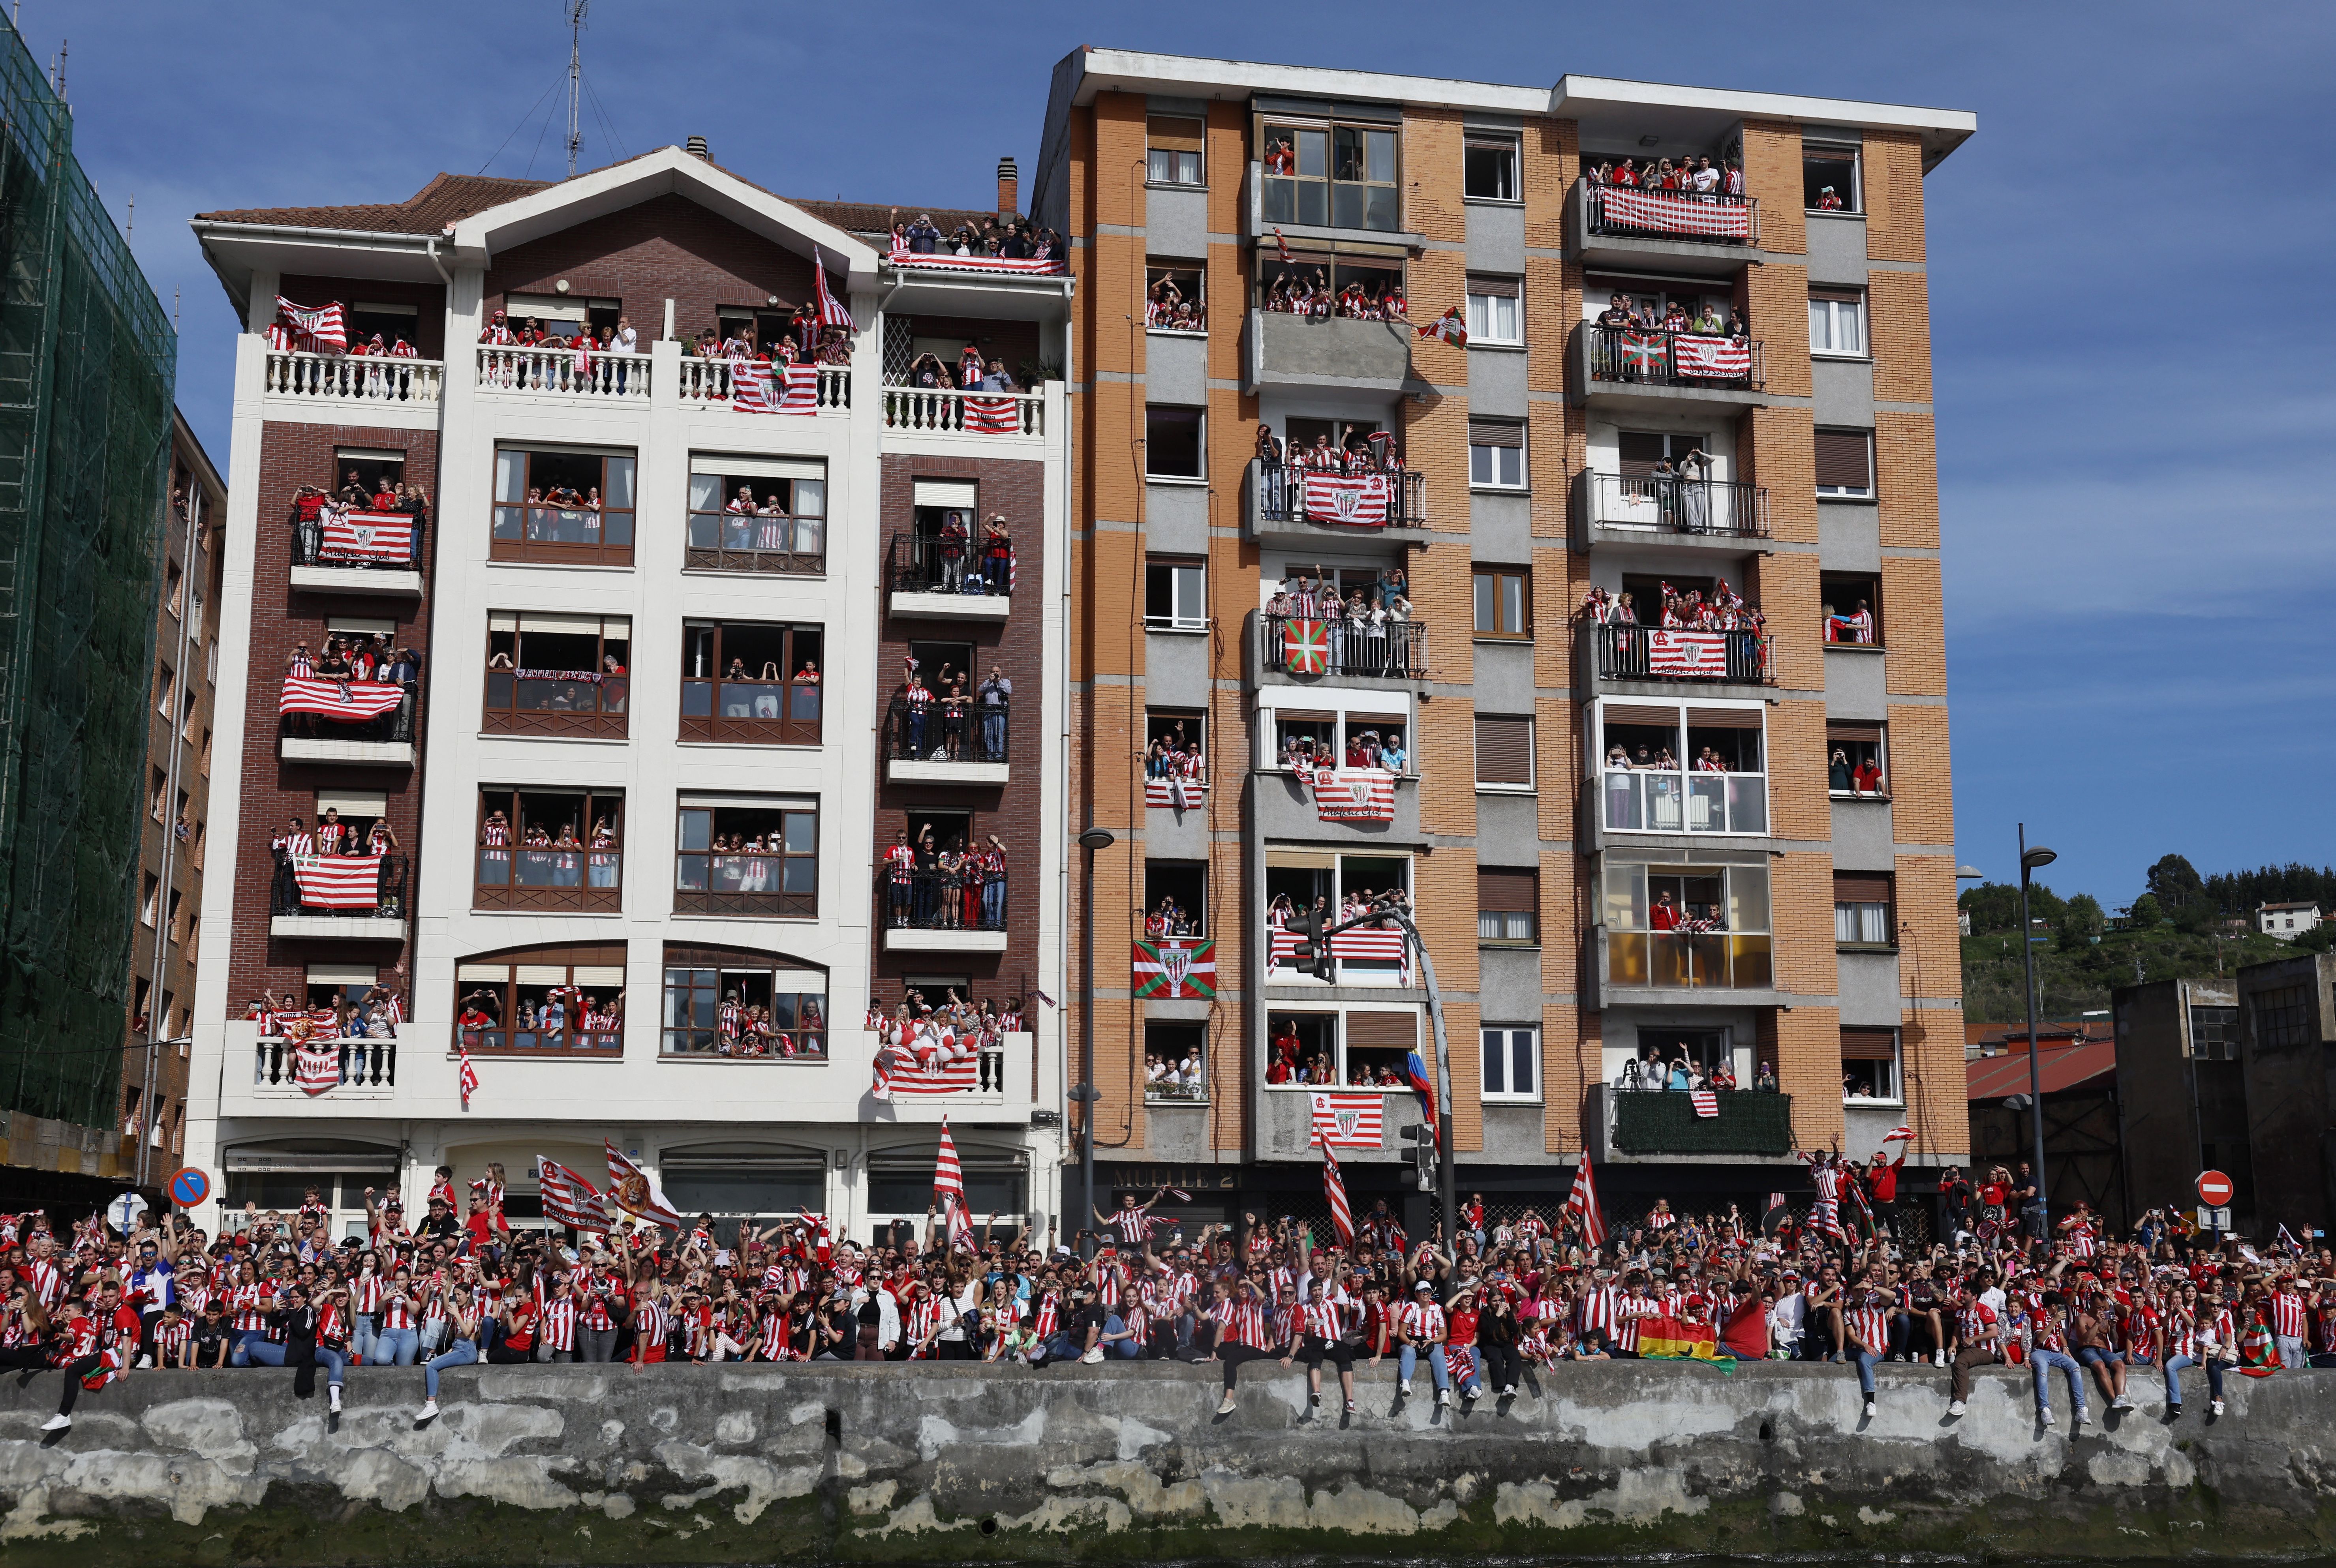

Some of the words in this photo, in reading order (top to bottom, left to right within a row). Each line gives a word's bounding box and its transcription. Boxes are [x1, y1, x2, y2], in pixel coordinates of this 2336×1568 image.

[525, 669, 591, 681] ATHTIC
[1169, 975, 1183, 987] BILBAO
[1341, 1131, 1353, 1139] BILBAO
[1113, 1169, 1209, 1188] MUELLE
[1220, 1169, 1243, 1188] 21
[73, 1333, 96, 1357] 30
